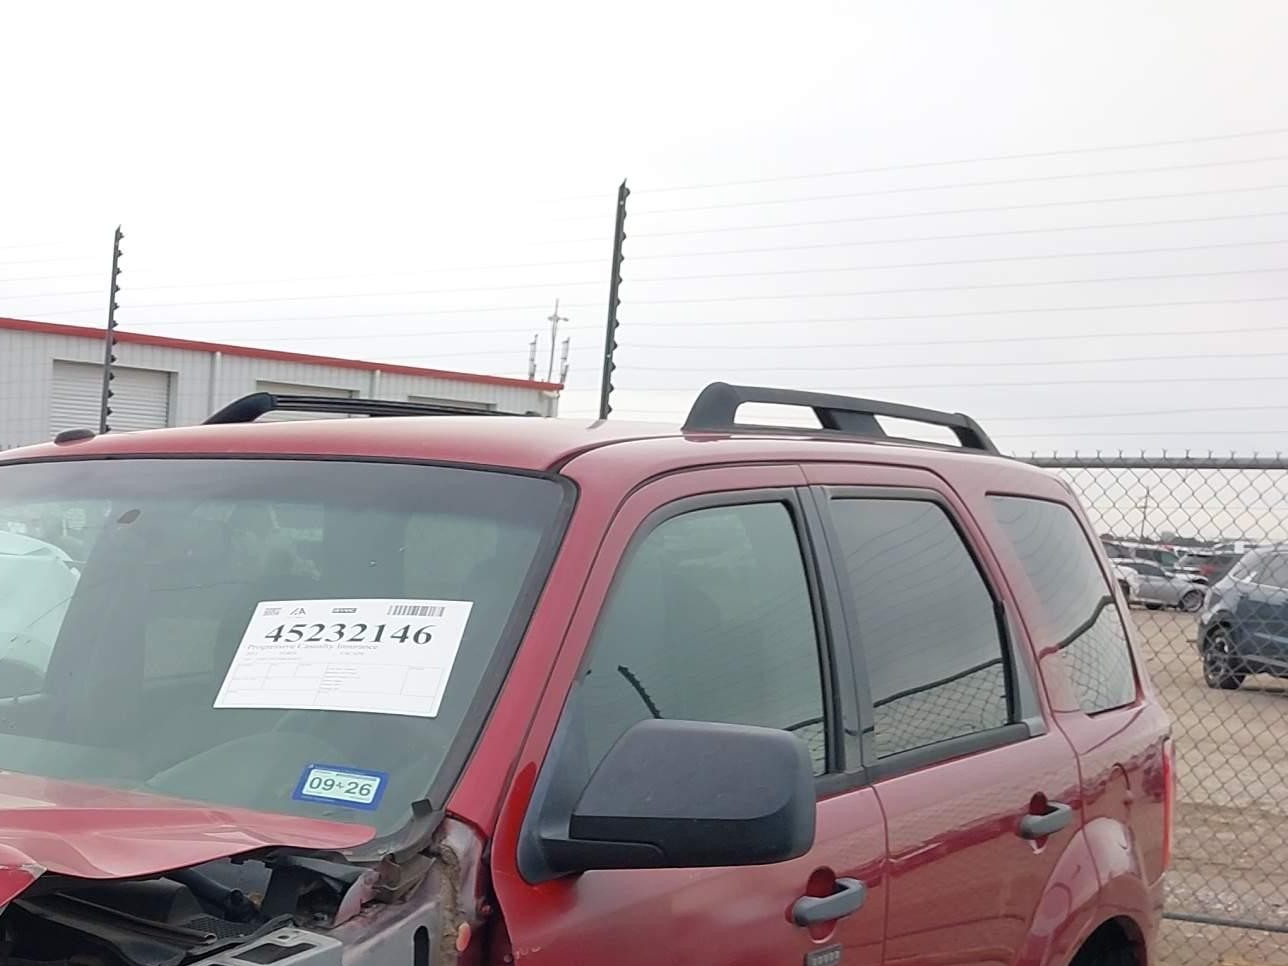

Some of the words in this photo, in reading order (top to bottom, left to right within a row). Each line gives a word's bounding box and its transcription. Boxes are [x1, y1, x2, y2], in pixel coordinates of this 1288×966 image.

[265, 623, 436, 645] 45232146
[309, 776, 335, 791] 09
[343, 781, 372, 797] 26
